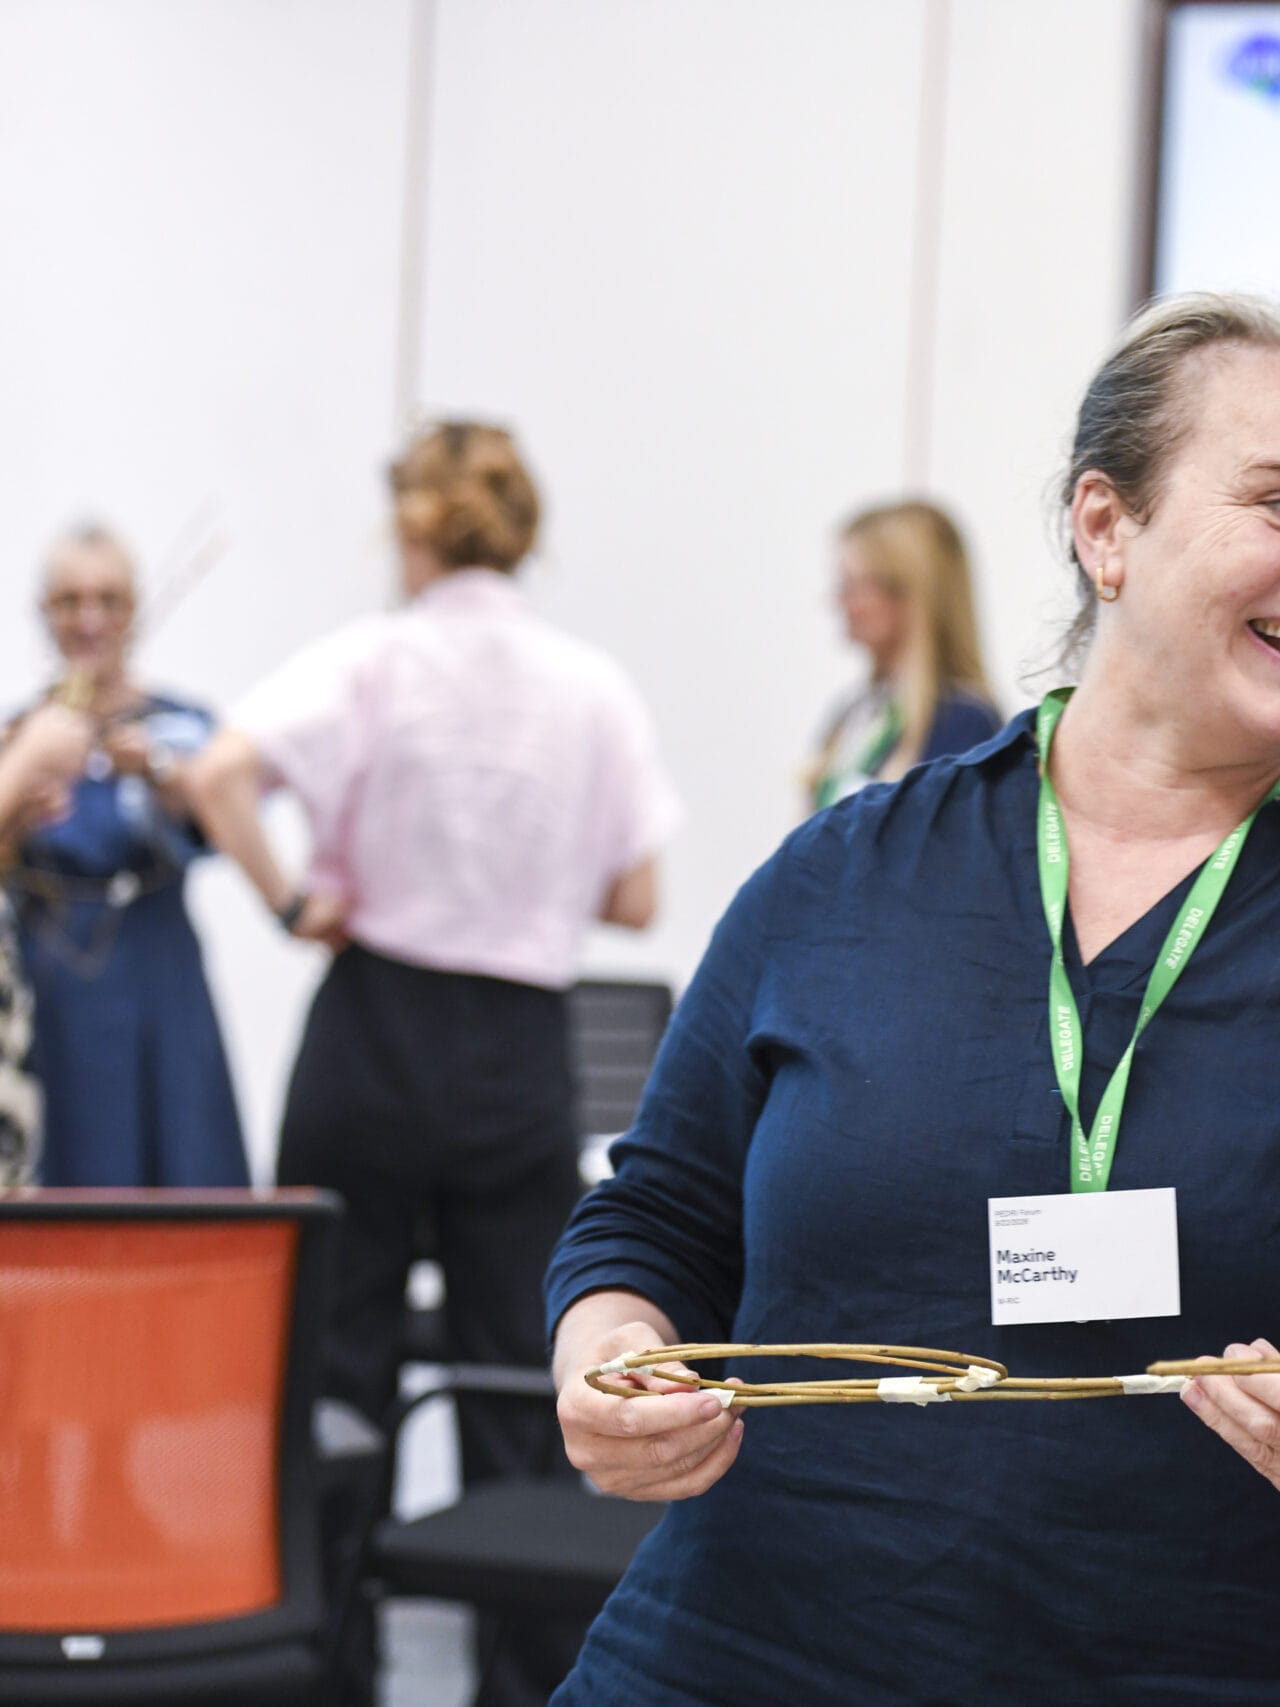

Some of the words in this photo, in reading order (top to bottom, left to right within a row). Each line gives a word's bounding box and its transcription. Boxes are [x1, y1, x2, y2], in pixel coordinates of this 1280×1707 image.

[1047, 803, 1062, 863] DELEGATE
[1166, 907, 1204, 970] DELEGATE
[1057, 1005, 1073, 1071] DELEGATE
[997, 1248, 1056, 1264] Maxine
[997, 1266, 1078, 1284] McCarthy
